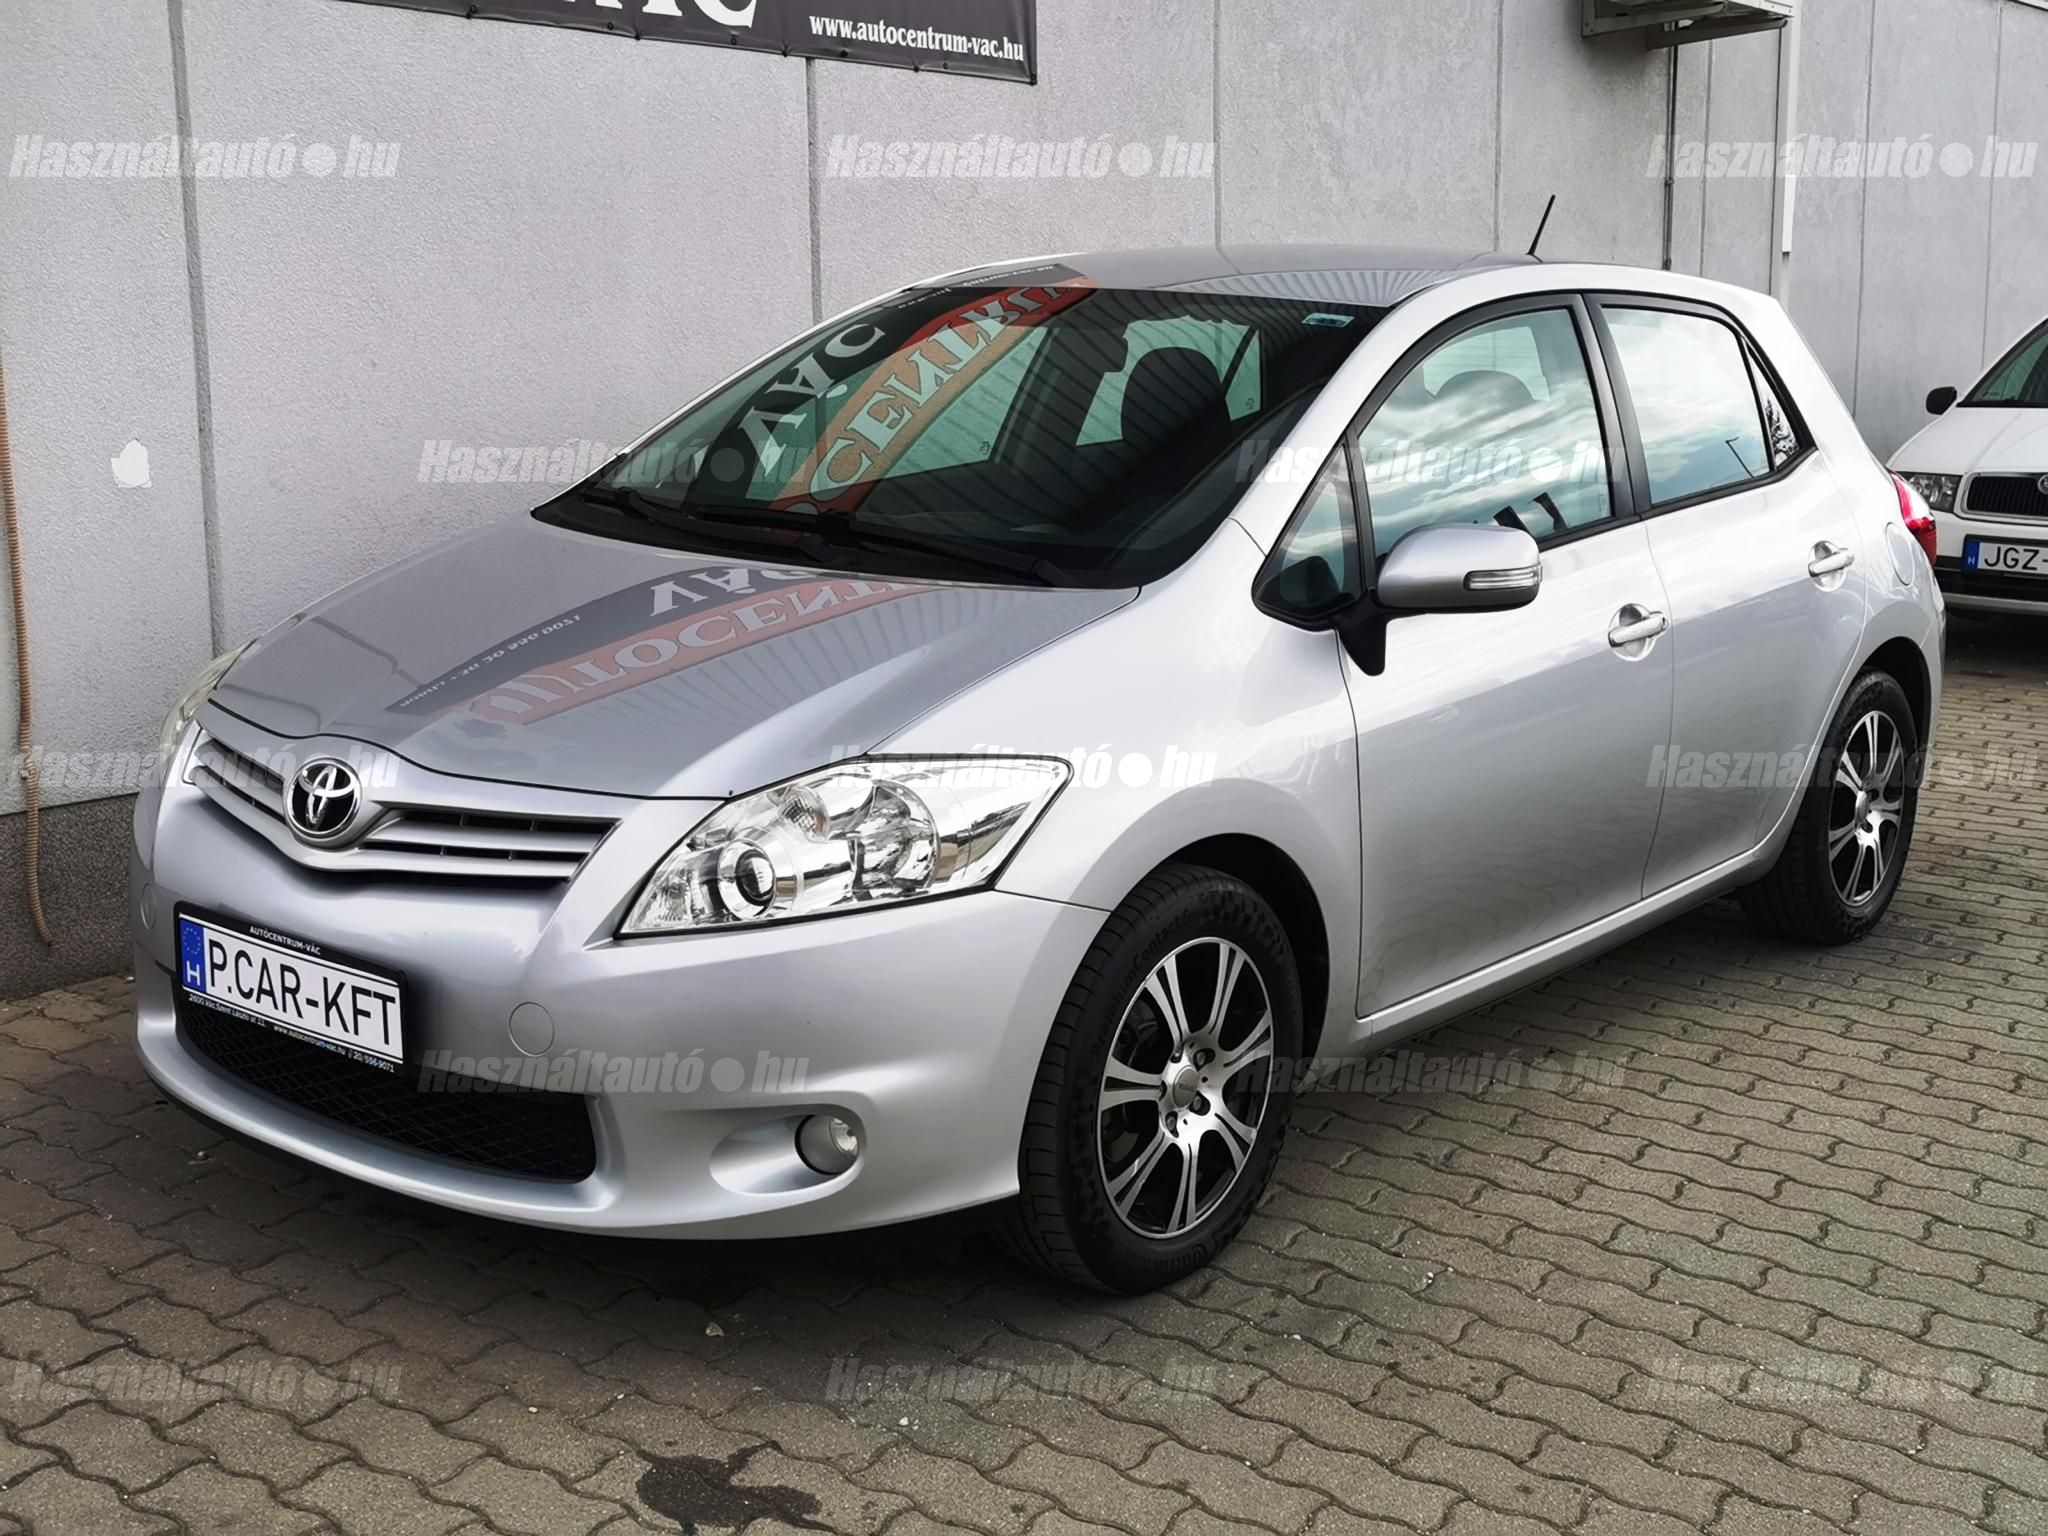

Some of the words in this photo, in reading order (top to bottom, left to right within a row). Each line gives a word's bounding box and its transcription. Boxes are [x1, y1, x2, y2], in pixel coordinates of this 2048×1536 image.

[809, 15, 1024, 62] www.autocentrum-vac.hu
[185, 960, 201, 987] H
[208, 938, 397, 1046] P.CAR-KFT
